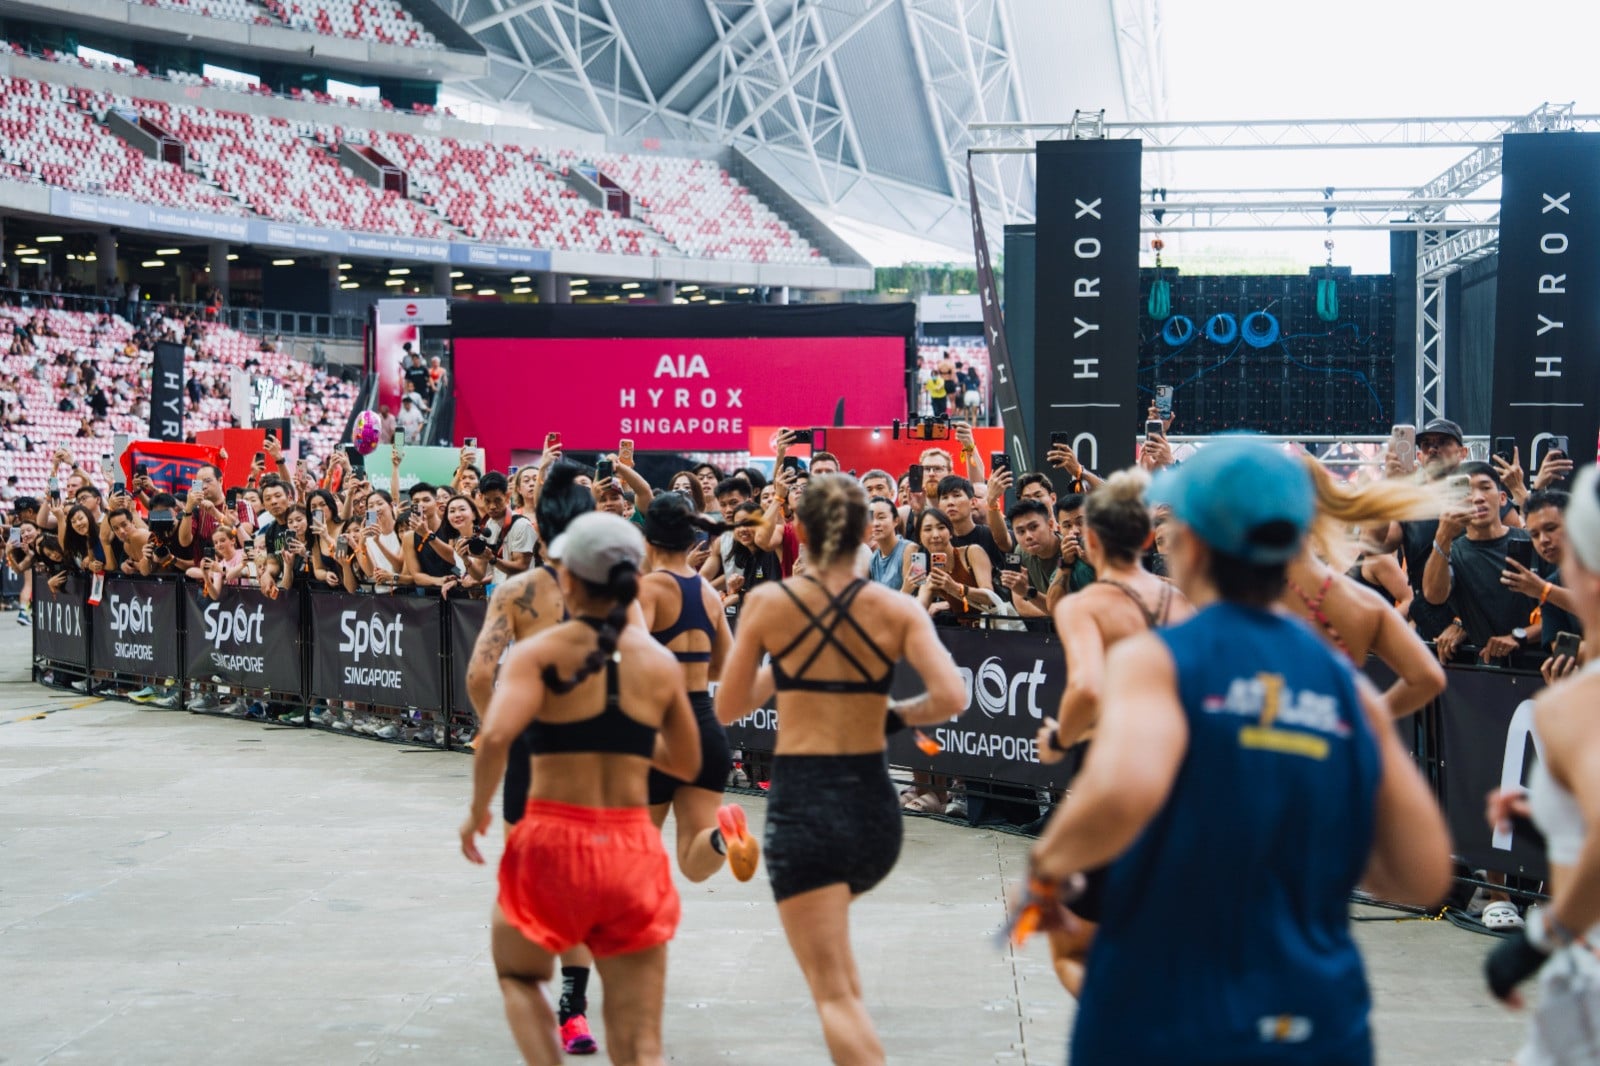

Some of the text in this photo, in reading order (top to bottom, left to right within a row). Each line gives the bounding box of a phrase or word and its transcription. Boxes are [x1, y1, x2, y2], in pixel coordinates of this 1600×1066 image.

[1073, 197, 1101, 379] HYROX
[1534, 191, 1571, 378] HYROX
[653, 353, 710, 378] AIA
[620, 387, 743, 409] HYROX
[620, 417, 743, 434] SINGAPORE
[38, 600, 82, 637] HYROX
[110, 594, 154, 639] Sport
[204, 602, 264, 649] Sport
[114, 641, 153, 661] SINGAPORE
[339, 610, 403, 662] Sport
[210, 652, 264, 673] SINGAPORE
[344, 666, 402, 689] SINGAPORE
[935, 728, 1041, 763] SINGAPORE
